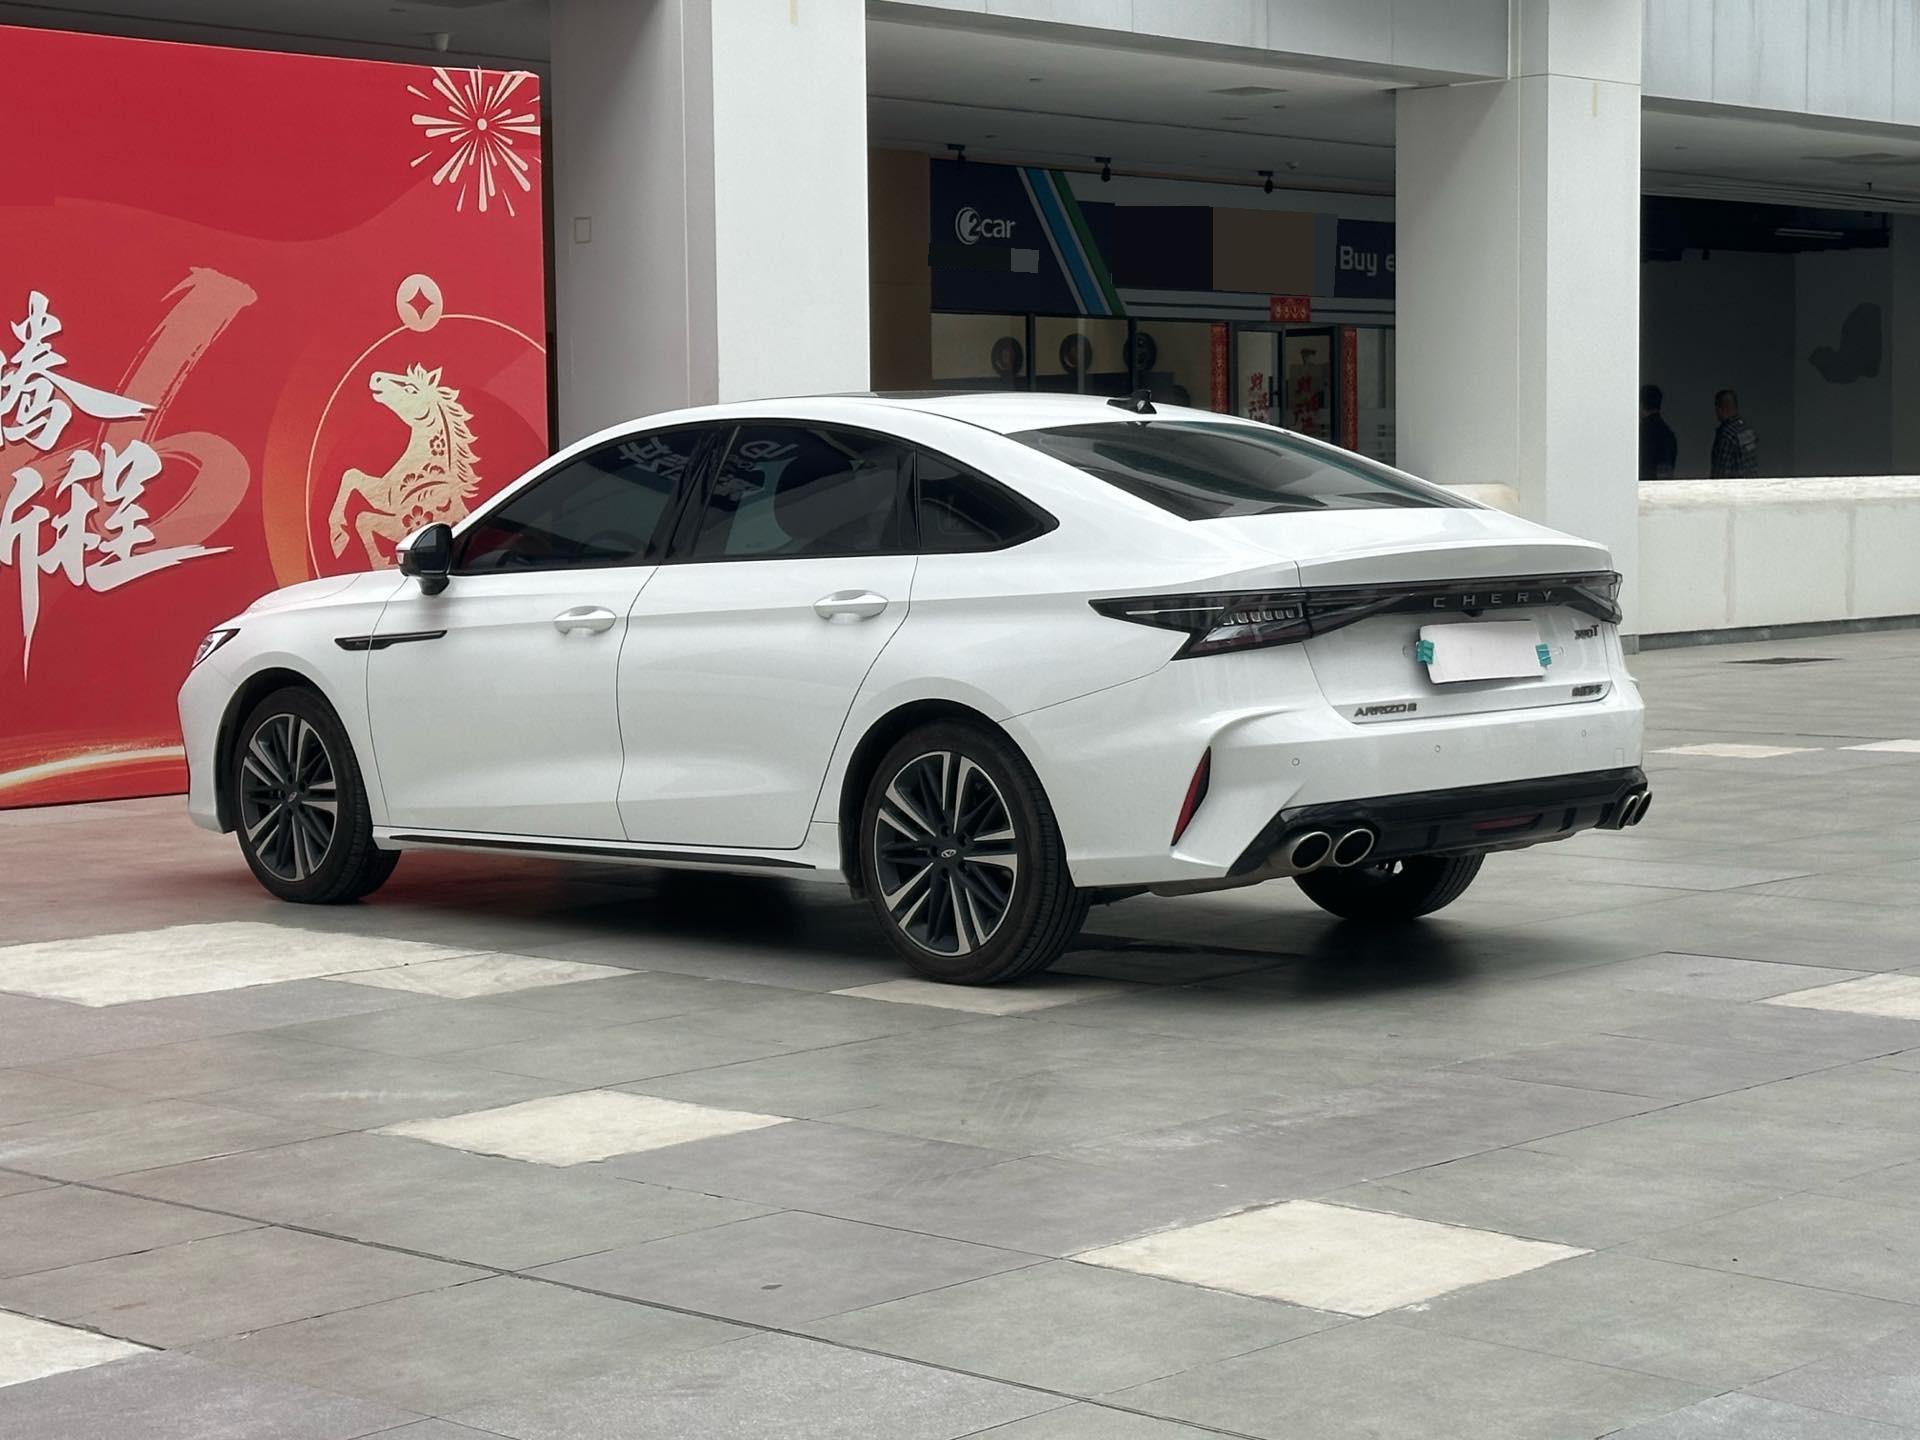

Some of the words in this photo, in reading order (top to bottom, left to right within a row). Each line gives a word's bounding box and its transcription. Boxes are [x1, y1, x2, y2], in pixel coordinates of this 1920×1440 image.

[1340, 245, 1377, 277] Buy
[1432, 590, 1552, 608] CHERY
[1354, 703, 1407, 717] ARRIZO
